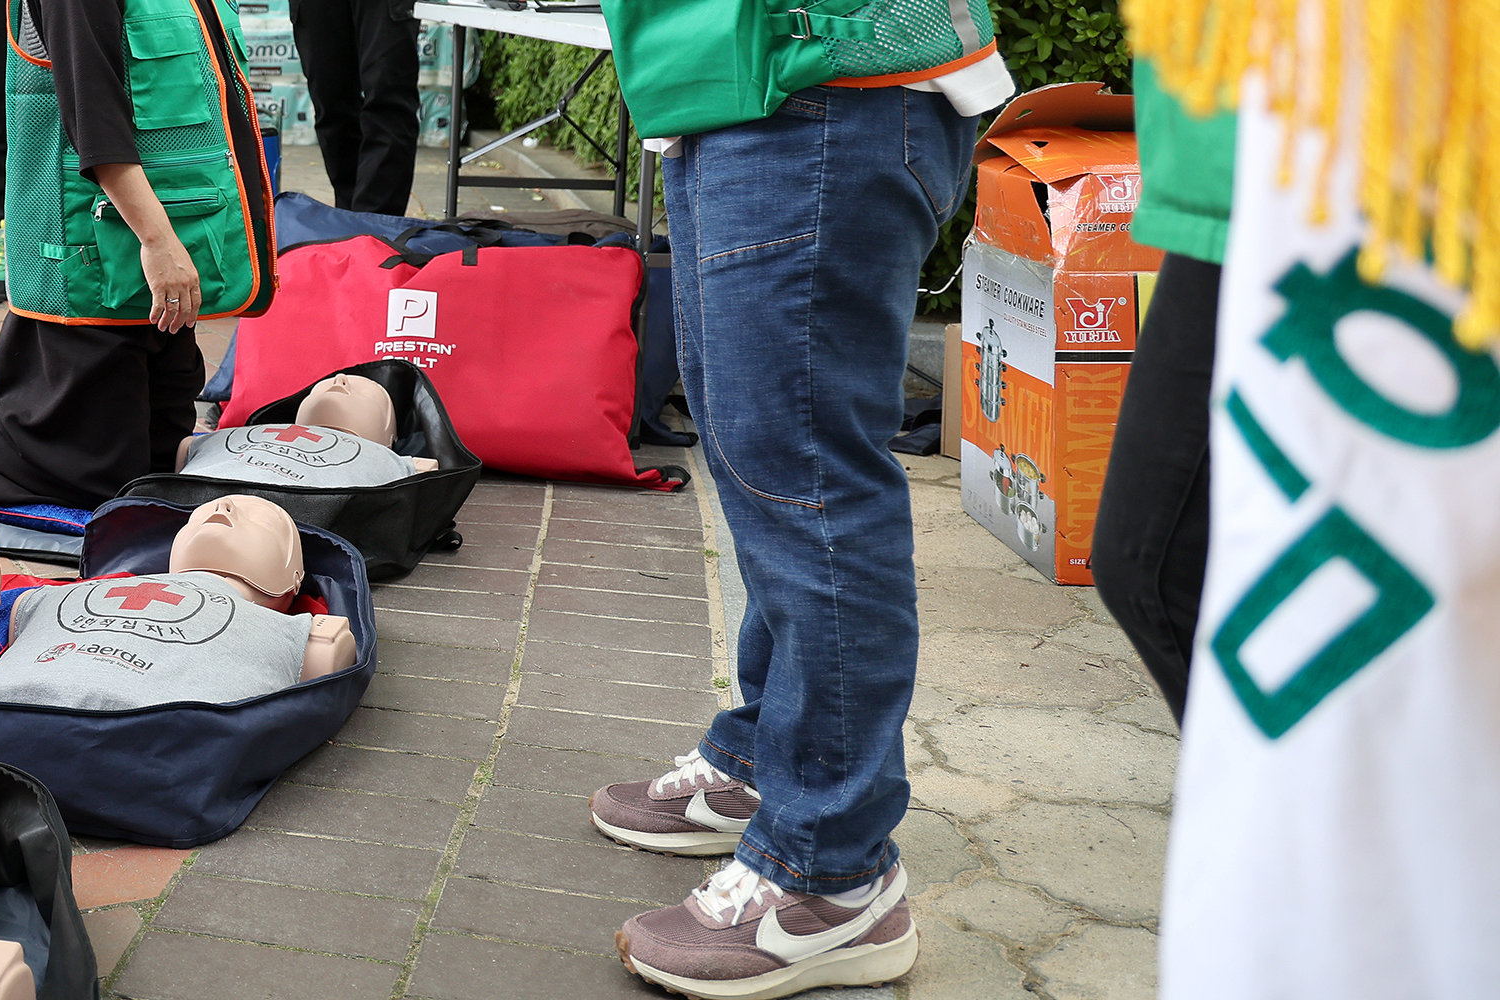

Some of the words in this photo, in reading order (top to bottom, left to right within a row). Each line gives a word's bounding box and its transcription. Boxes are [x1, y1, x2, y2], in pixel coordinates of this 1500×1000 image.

[247, 43, 298, 60] Towe
[1100, 202, 1137, 213] YUEJ
[1076, 222, 1116, 232] STEAMER
[975, 273, 1001, 300] STEAMER
[1003, 286, 1045, 319] COOKWARE
[1064, 330, 1121, 343] YUEJIA
[374, 341, 452, 356] PRESTAN
[246, 455, 305, 480] Laerdal
[71, 614, 187, 640] 대한적십자사
[76, 643, 154, 671] Laerdal
